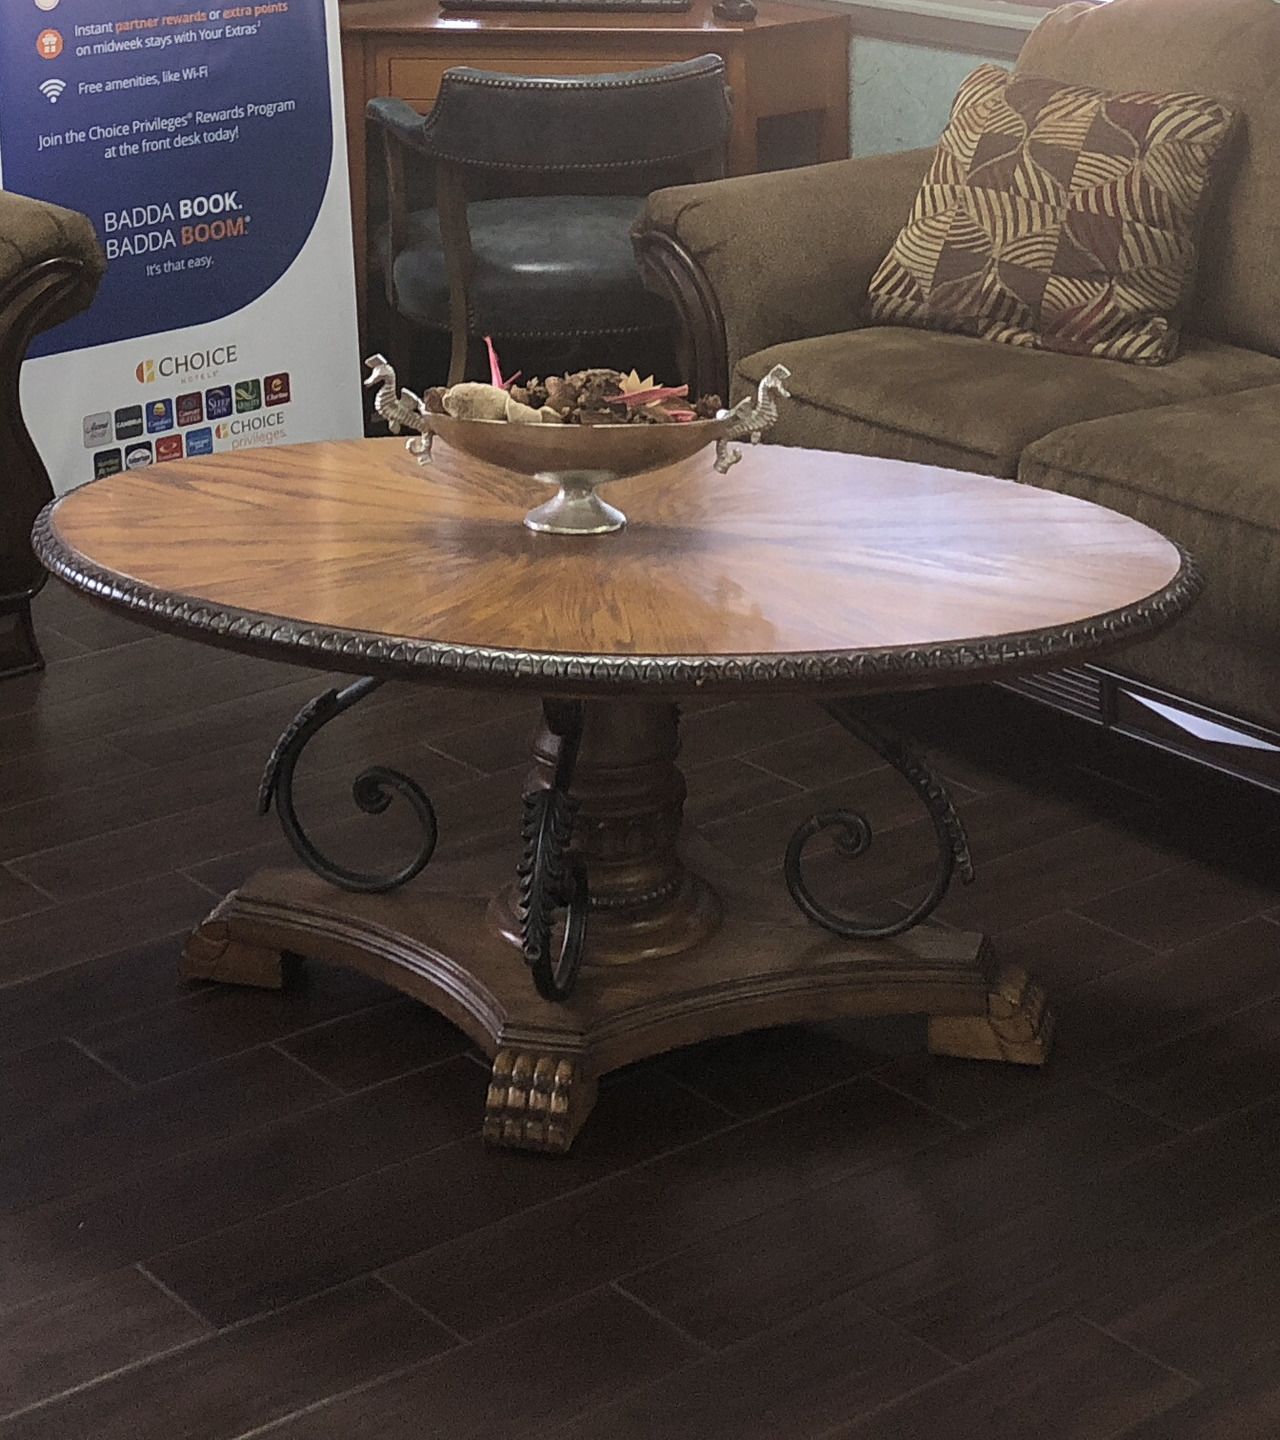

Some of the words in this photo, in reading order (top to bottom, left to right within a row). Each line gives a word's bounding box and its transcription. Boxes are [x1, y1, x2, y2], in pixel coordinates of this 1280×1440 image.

[74, 21, 114, 37] Instant
[115, 17, 159, 35] partner
[162, 10, 208, 26] rewards
[209, 9, 221, 20] or
[223, 5, 252, 19] extra
[254, 0, 289, 17] points
[75, 46, 91, 57] on
[93, 36, 143, 54] midweek
[144, 35, 172, 49] stays
[174, 29, 197, 44] with
[198, 28, 224, 40] Your
[78, 82, 103, 95] Free
[105, 74, 161, 92] amenities,
[162, 70, 180, 83] like
[182, 65, 208, 80] Wi-Fi
[38, 132, 63, 151] Join
[65, 129, 86, 144] the
[88, 123, 130, 140] Choice
[195, 105, 245, 124] Rewards
[246, 99, 296, 117] Program
[104, 146, 117, 159] at
[118, 142, 139, 157] the
[141, 137, 171, 152] front
[173, 131, 201, 148] desk
[203, 125, 239, 143] today!
[104, 202, 175, 233] BADDA
[179, 191, 243, 220] BOOK.
[106, 229, 177, 260] BADDA
[146, 264, 161, 277] It's
[163, 259, 186, 274] that
[187, 255, 215, 271] easy.
[158, 344, 238, 377] CHOICE
[230, 411, 285, 435] CHOICE
